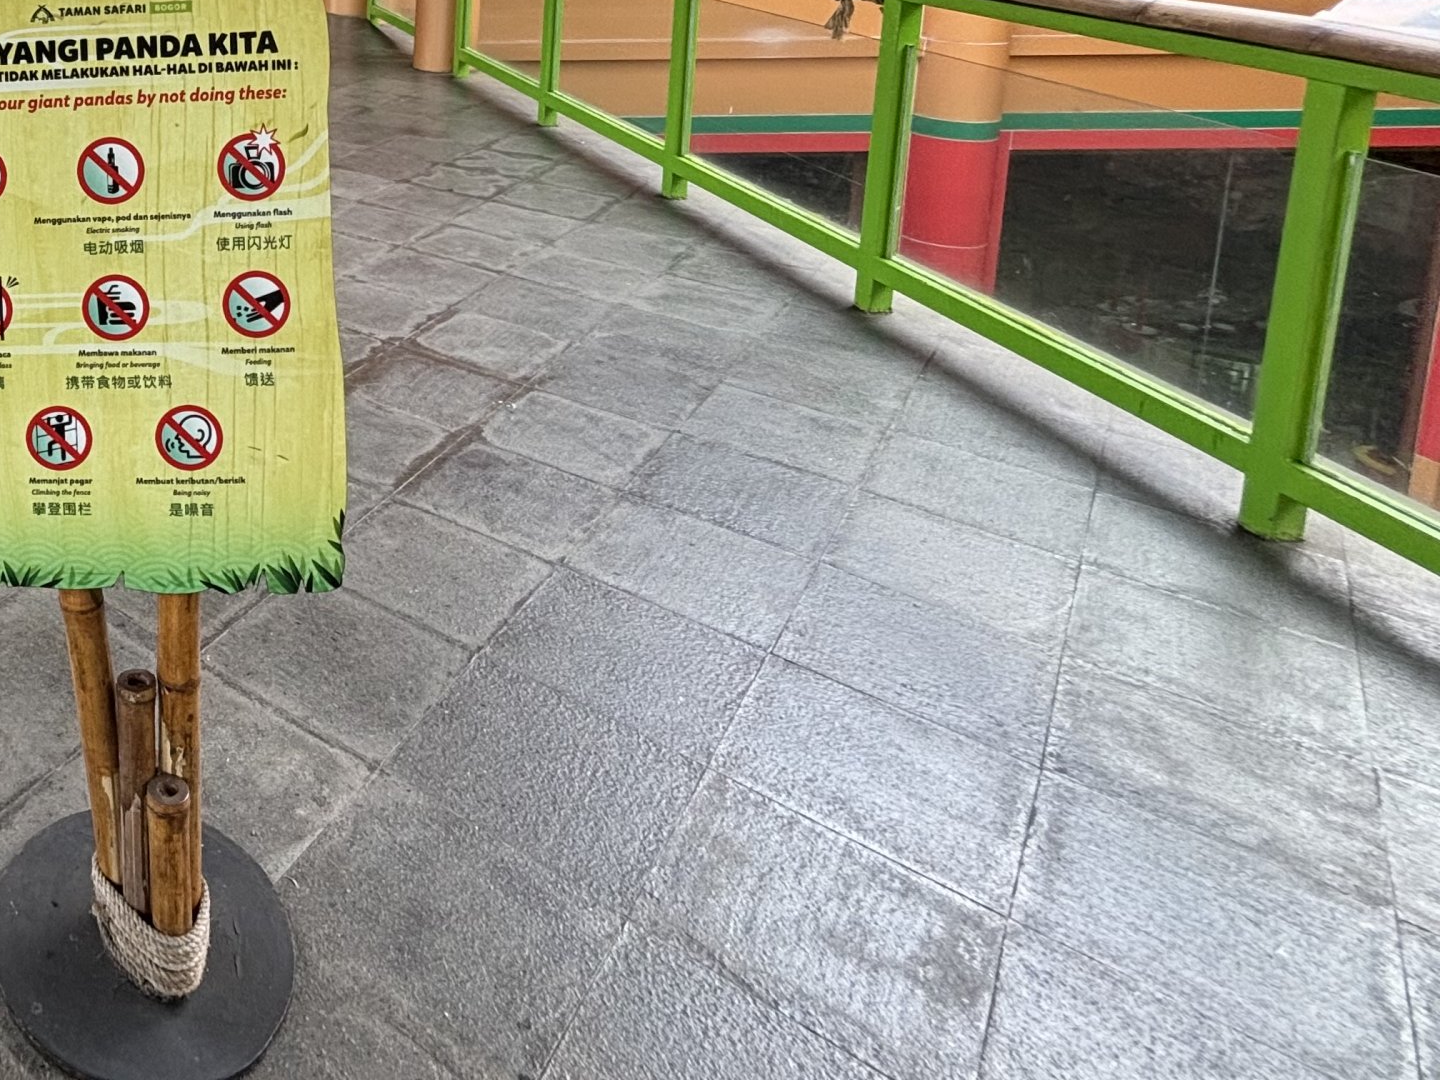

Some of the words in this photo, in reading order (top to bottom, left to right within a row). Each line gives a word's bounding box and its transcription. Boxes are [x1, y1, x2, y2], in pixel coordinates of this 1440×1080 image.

[58, 6, 100, 17] TAMAN
[104, 4, 146, 14] SAFARI
[154, 3, 188, 12] BOGOR
[96, 33, 203, 60] PANDA
[209, 30, 279, 56] KITA
[41, 65, 130, 81] MELAKUKAN
[132, 62, 196, 76] HAL-HAL
[198, 62, 212, 73] DI
[213, 59, 269, 73] BAWAH
[28, 94, 70, 114] giant
[73, 90, 133, 111] pandas
[137, 89, 157, 108] by
[159, 89, 186, 104] not
[189, 87, 235, 106] doing
[239, 84, 288, 100] these:
[33, 215, 91, 226] Menggunakan
[116, 213, 132, 222] pod
[133, 212, 149, 221] dan
[149, 212, 191, 222] sejenisnya
[213, 209, 272, 220] Menggunakan
[272, 208, 293, 217] flash
[86, 227, 111, 235] Electric
[111, 226, 140, 235] smoking
[235, 222, 255, 231] Using
[255, 221, 273, 231] flash
[83, 240, 145, 256] 电动吸烟
[216, 235, 293, 252] 使用闪光灯
[78, 349, 119, 357] Membawa
[120, 349, 157, 357] makanan
[221, 347, 257, 356] Memberi
[258, 346, 295, 355] makanan
[245, 358, 272, 367] Feeding
[65, 374, 173, 390] 携带食物或饮料
[244, 372, 275, 387] 馈送
[29, 477, 68, 486] Memanjat
[69, 478, 93, 486] pagar
